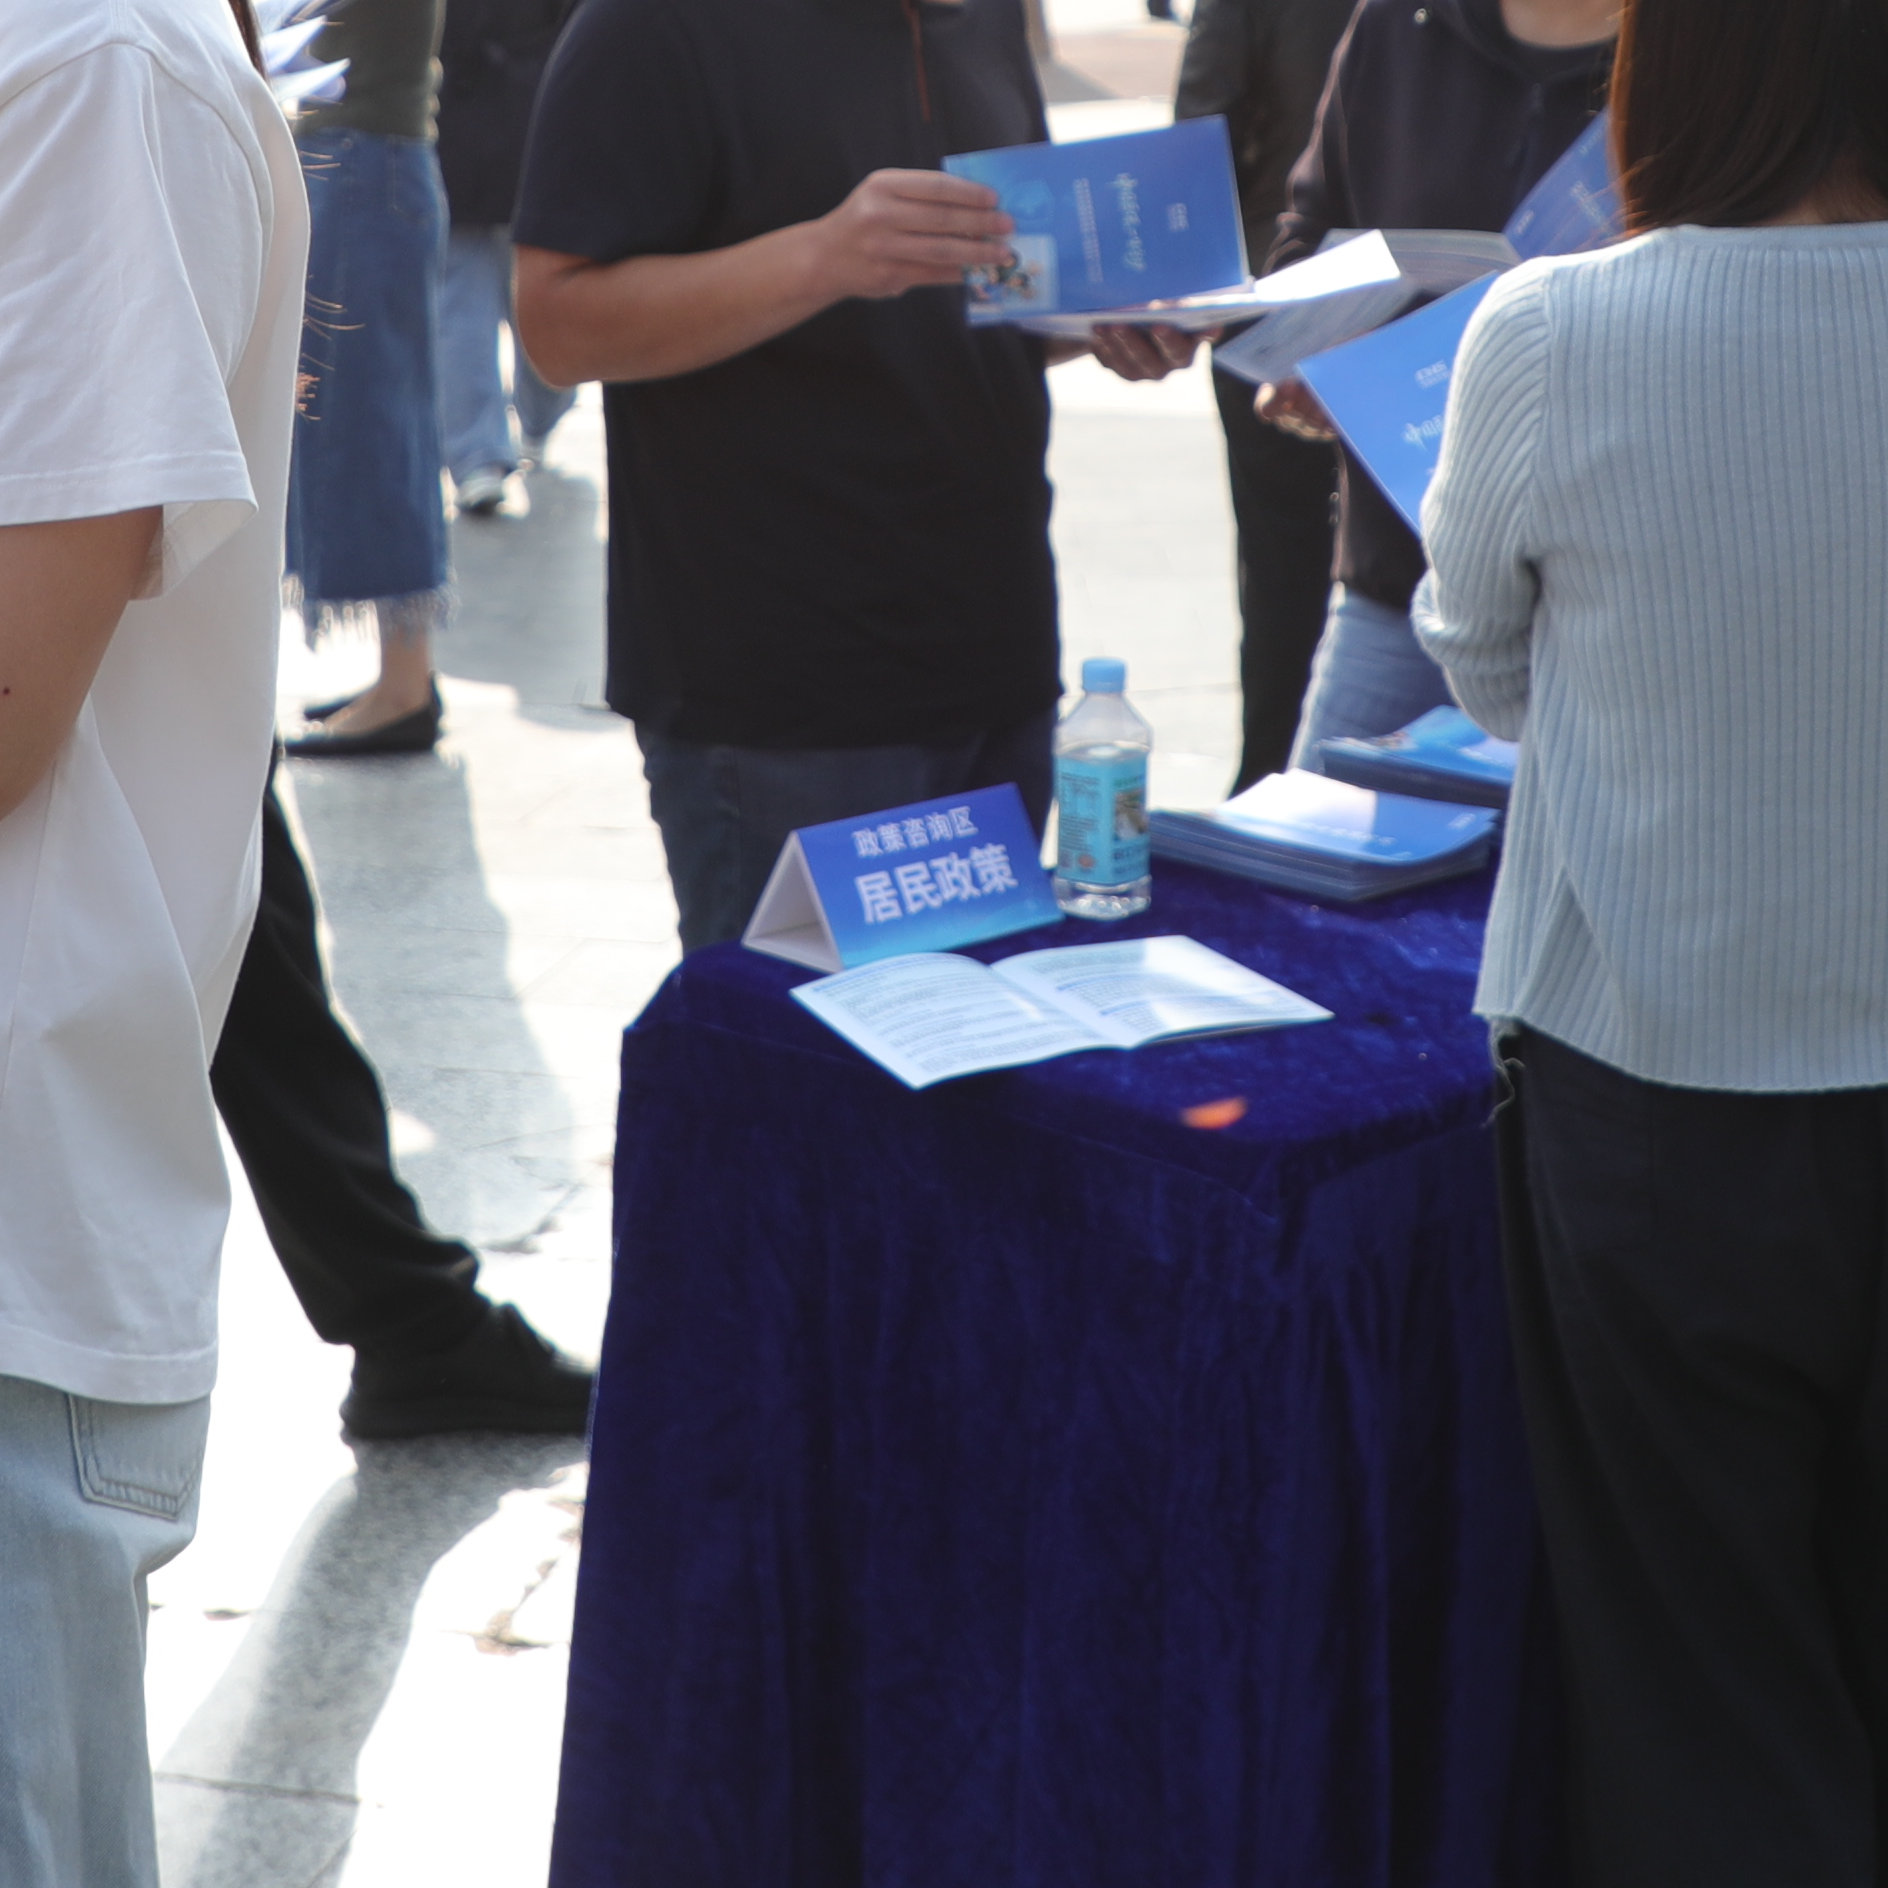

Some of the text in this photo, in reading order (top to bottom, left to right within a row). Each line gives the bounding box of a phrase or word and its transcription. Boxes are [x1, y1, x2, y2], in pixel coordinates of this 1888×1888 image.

[853, 806, 978, 856] 政策咨询区
[855, 843, 1018, 924] 居民政策
